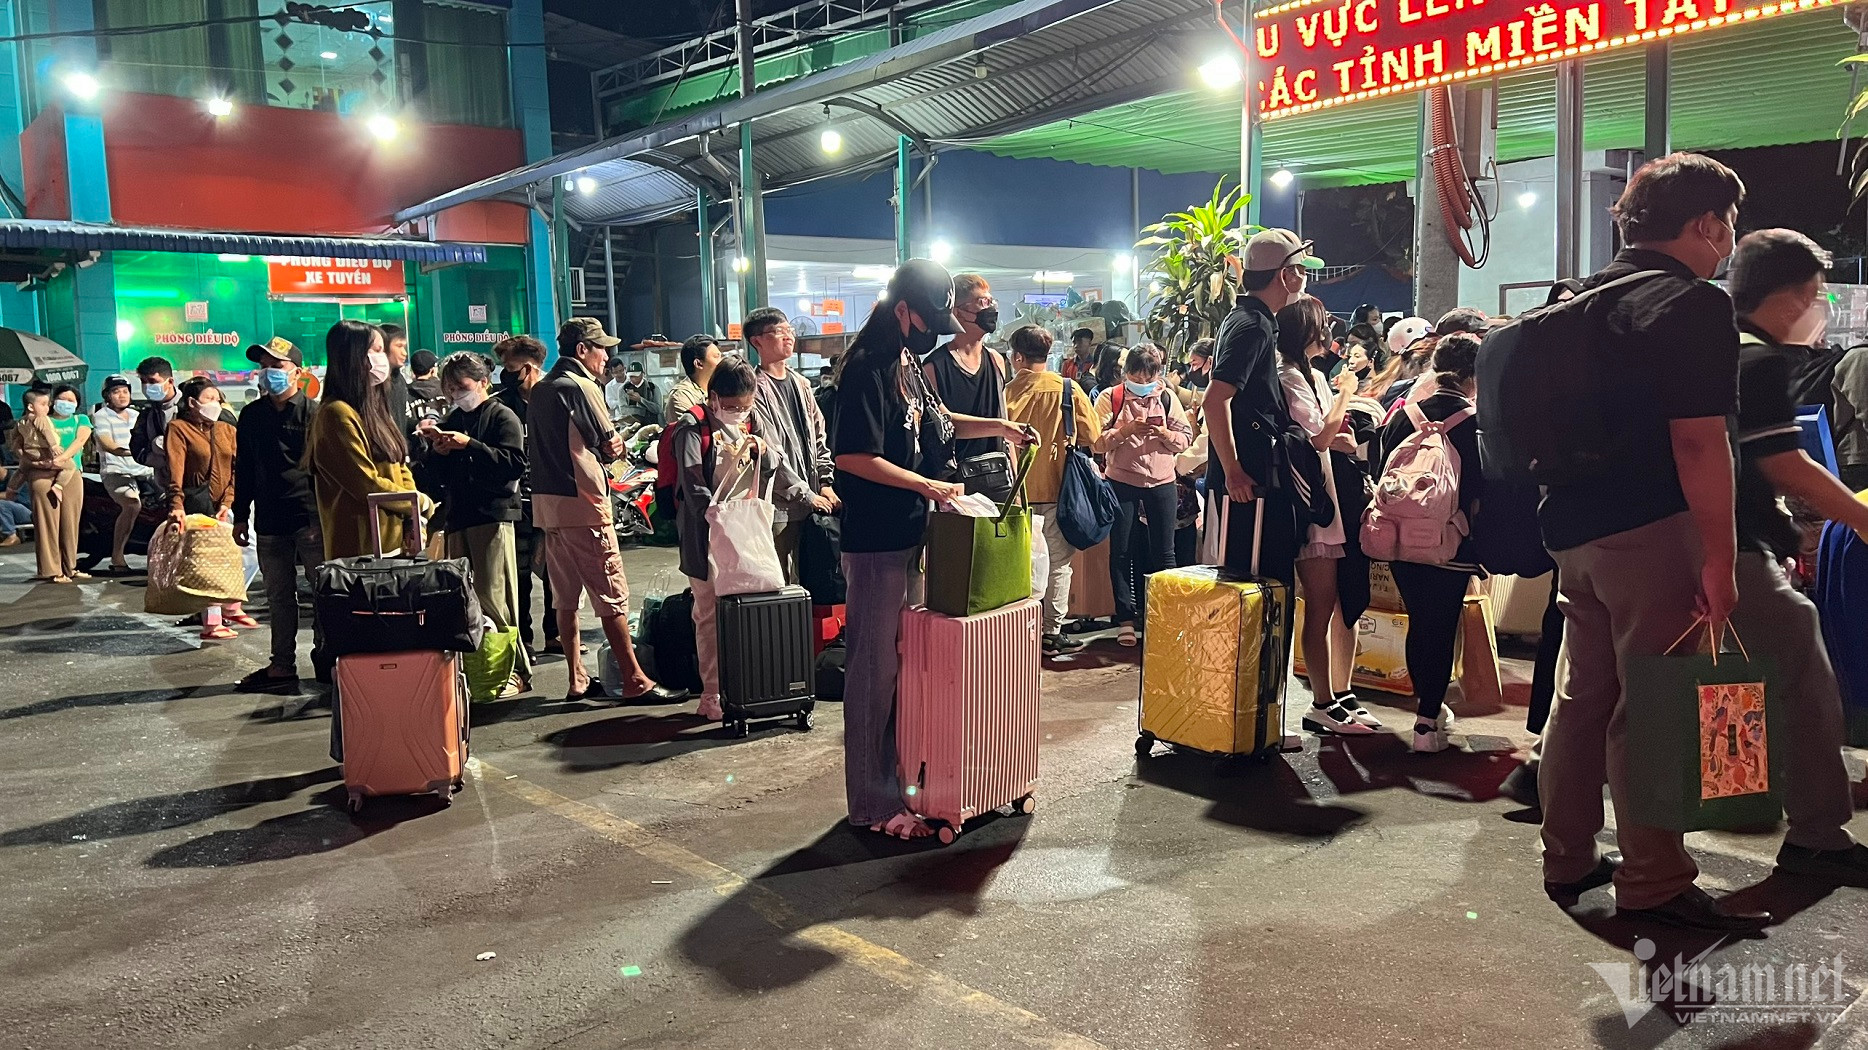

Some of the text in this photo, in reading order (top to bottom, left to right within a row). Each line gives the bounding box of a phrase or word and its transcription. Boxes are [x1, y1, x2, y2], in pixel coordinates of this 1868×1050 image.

[1295, 0, 1378, 47] VỰC
[1332, 44, 1443, 94] TỈNH
[1465, 2, 1600, 67] MIỀN
[305, 268, 371, 285] XE TUYẾN
